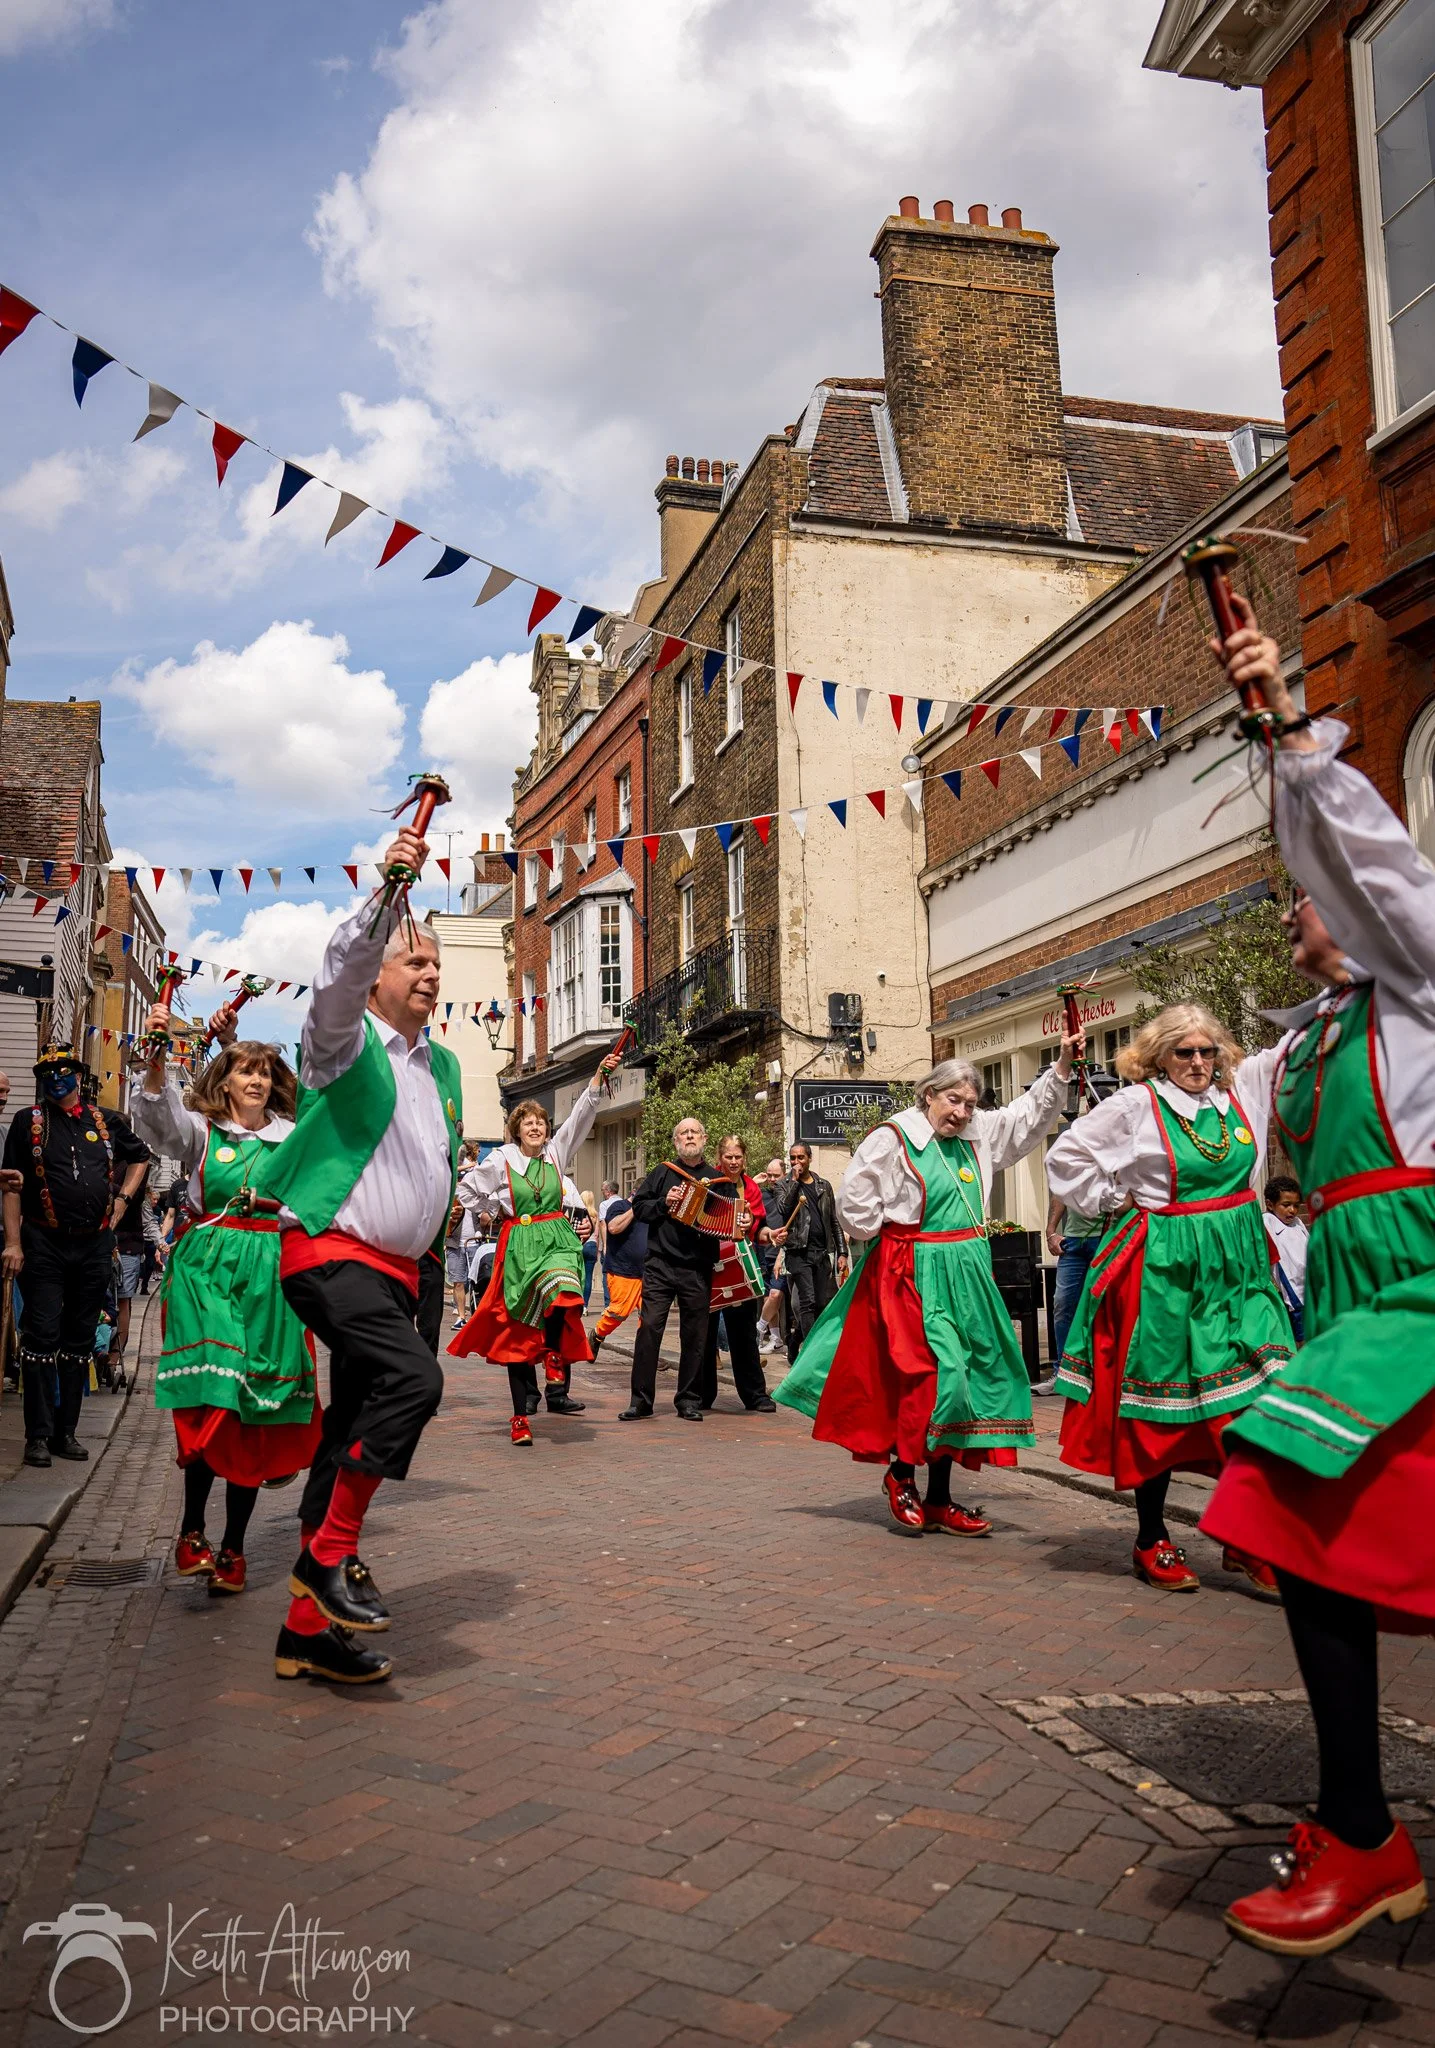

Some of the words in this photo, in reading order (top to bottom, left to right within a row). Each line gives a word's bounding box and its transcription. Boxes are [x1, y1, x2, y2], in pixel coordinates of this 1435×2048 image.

[1042, 1010, 1060, 1036] Olé
[1077, 997, 1117, 1026] chester
[965, 1038, 988, 1054] TAPAS
[990, 1032, 1006, 1047] BAR
[802, 1094, 873, 1112] CHELDGATE
